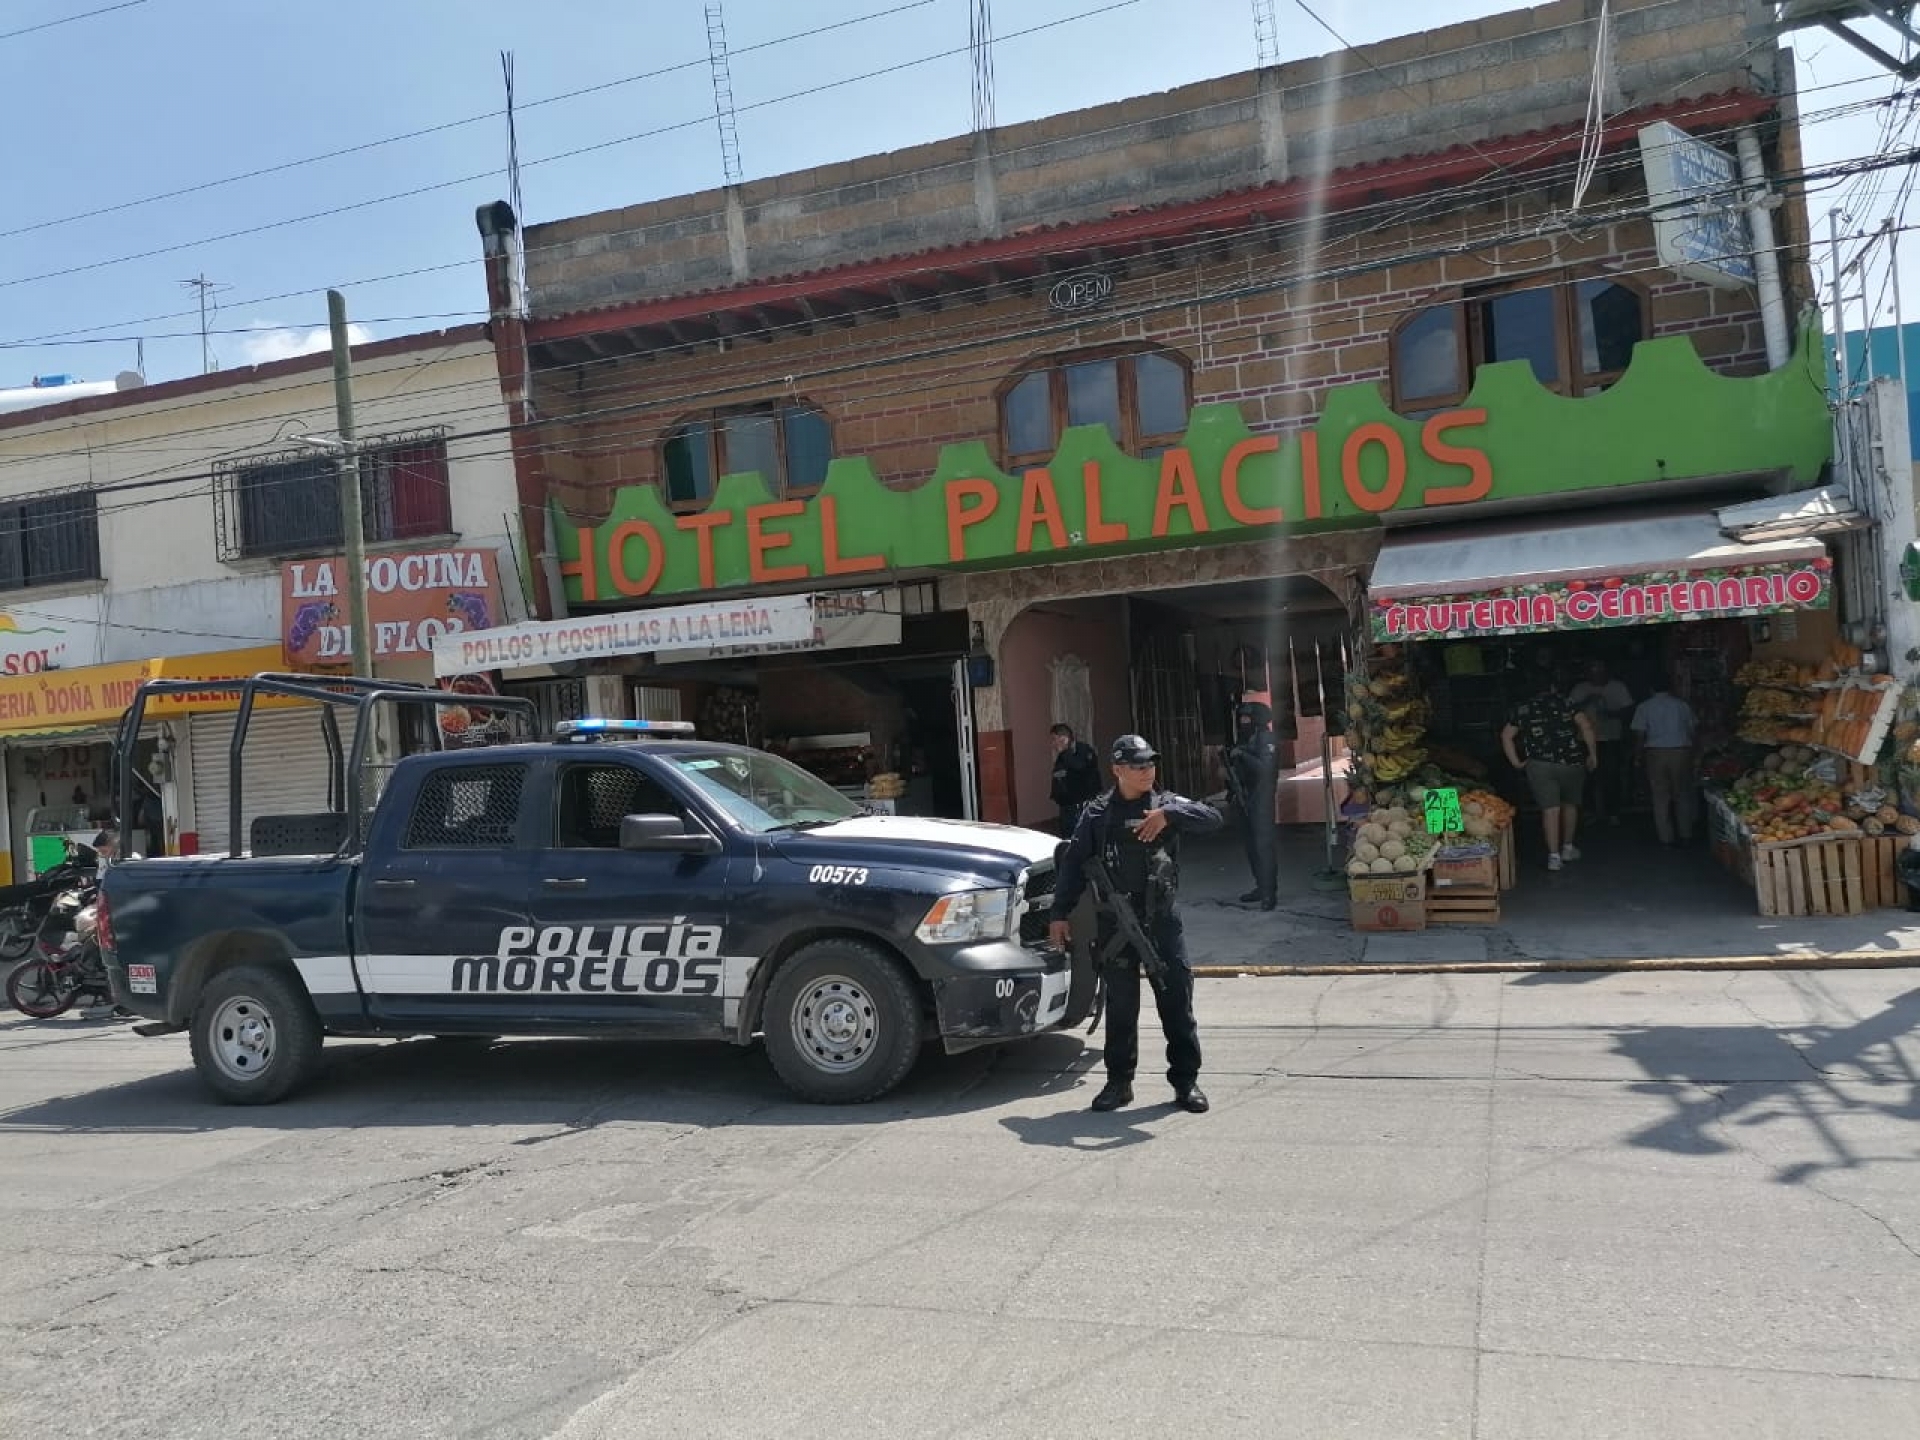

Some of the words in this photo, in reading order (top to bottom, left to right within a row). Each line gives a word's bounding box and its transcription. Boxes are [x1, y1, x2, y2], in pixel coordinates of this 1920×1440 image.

[1055, 275, 1111, 307] OPEN
[562, 494, 887, 601] HOTEL
[943, 407, 1493, 562] PALACIOS
[290, 563, 338, 598] LA
[363, 552, 488, 593] OCINA
[1386, 593, 1556, 635] FRUTERIA
[1565, 569, 1821, 622] CENTENARIO
[462, 633, 533, 666] POLLOS
[538, 632, 552, 657] Y
[557, 618, 661, 655] COSTILLAS
[667, 617, 682, 643] A
[687, 613, 714, 641] LA
[718, 607, 773, 638] LEÑA
[809, 864, 869, 886] 00573
[452, 956, 723, 995] MORELOS
[995, 978, 1015, 999] 00
